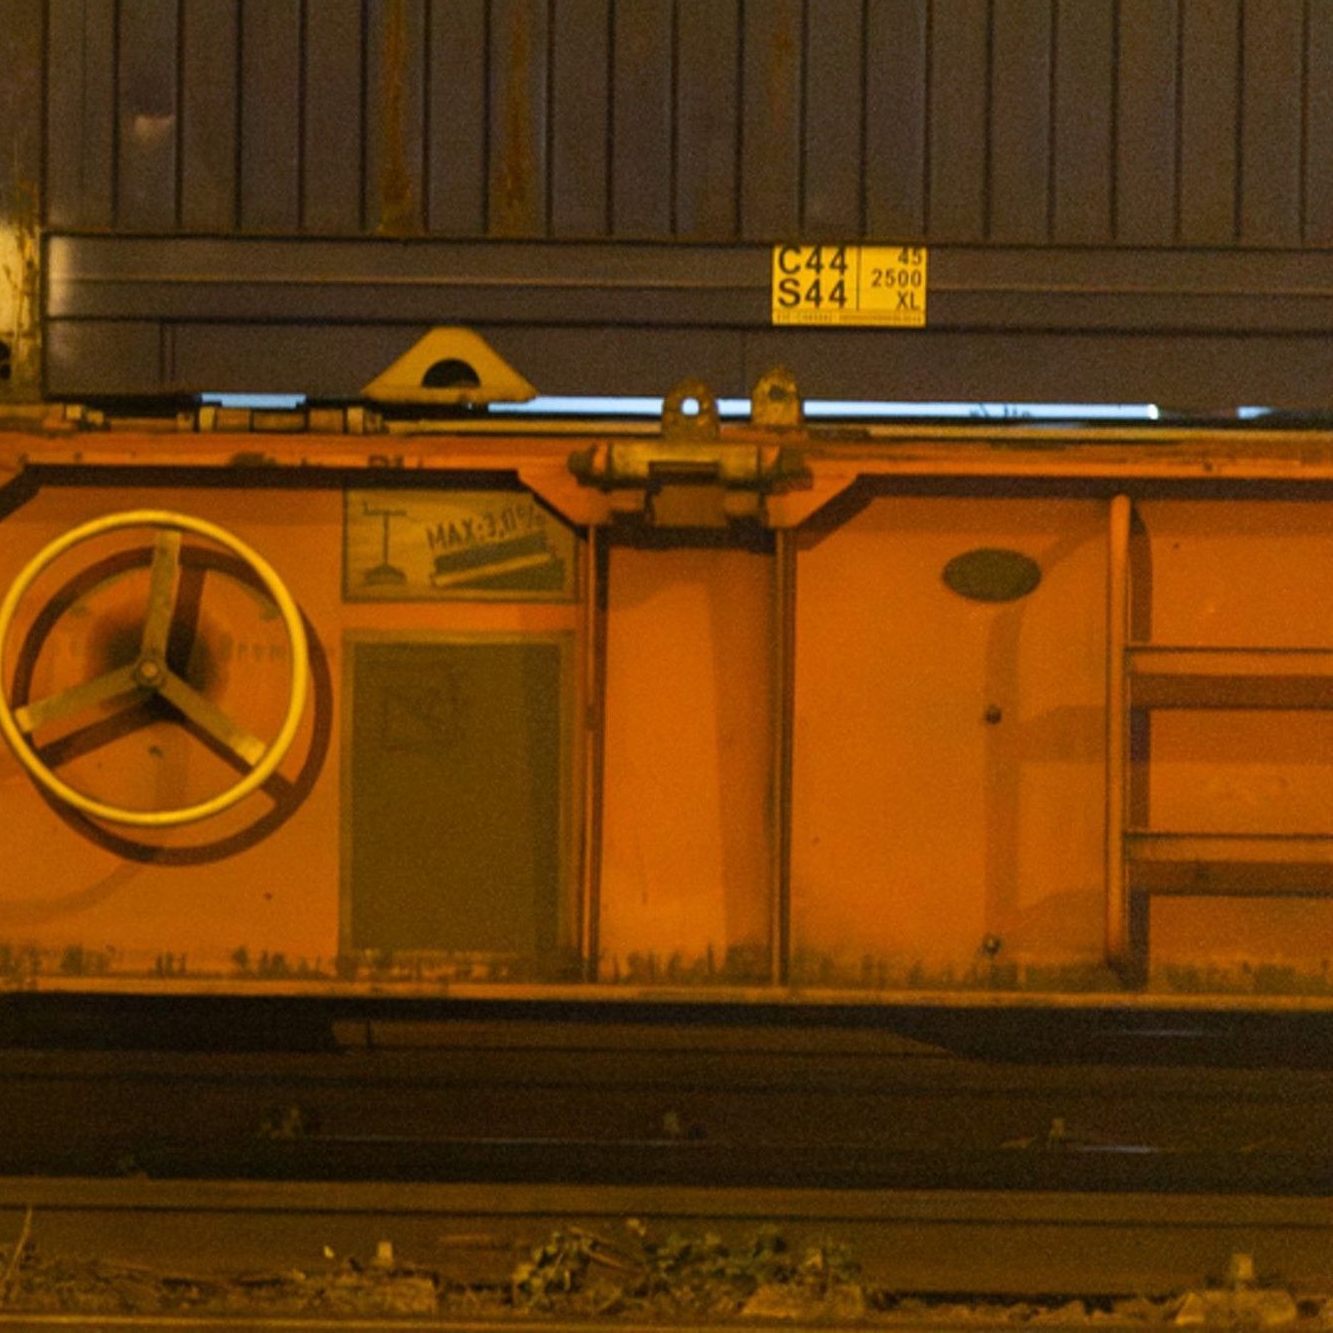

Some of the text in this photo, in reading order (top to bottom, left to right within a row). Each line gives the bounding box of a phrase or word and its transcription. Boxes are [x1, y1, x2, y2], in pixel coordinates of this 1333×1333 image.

[778, 245, 848, 276] C44
[871, 268, 922, 287] 2500
[778, 277, 848, 309] S44
[896, 290, 921, 311] XL
